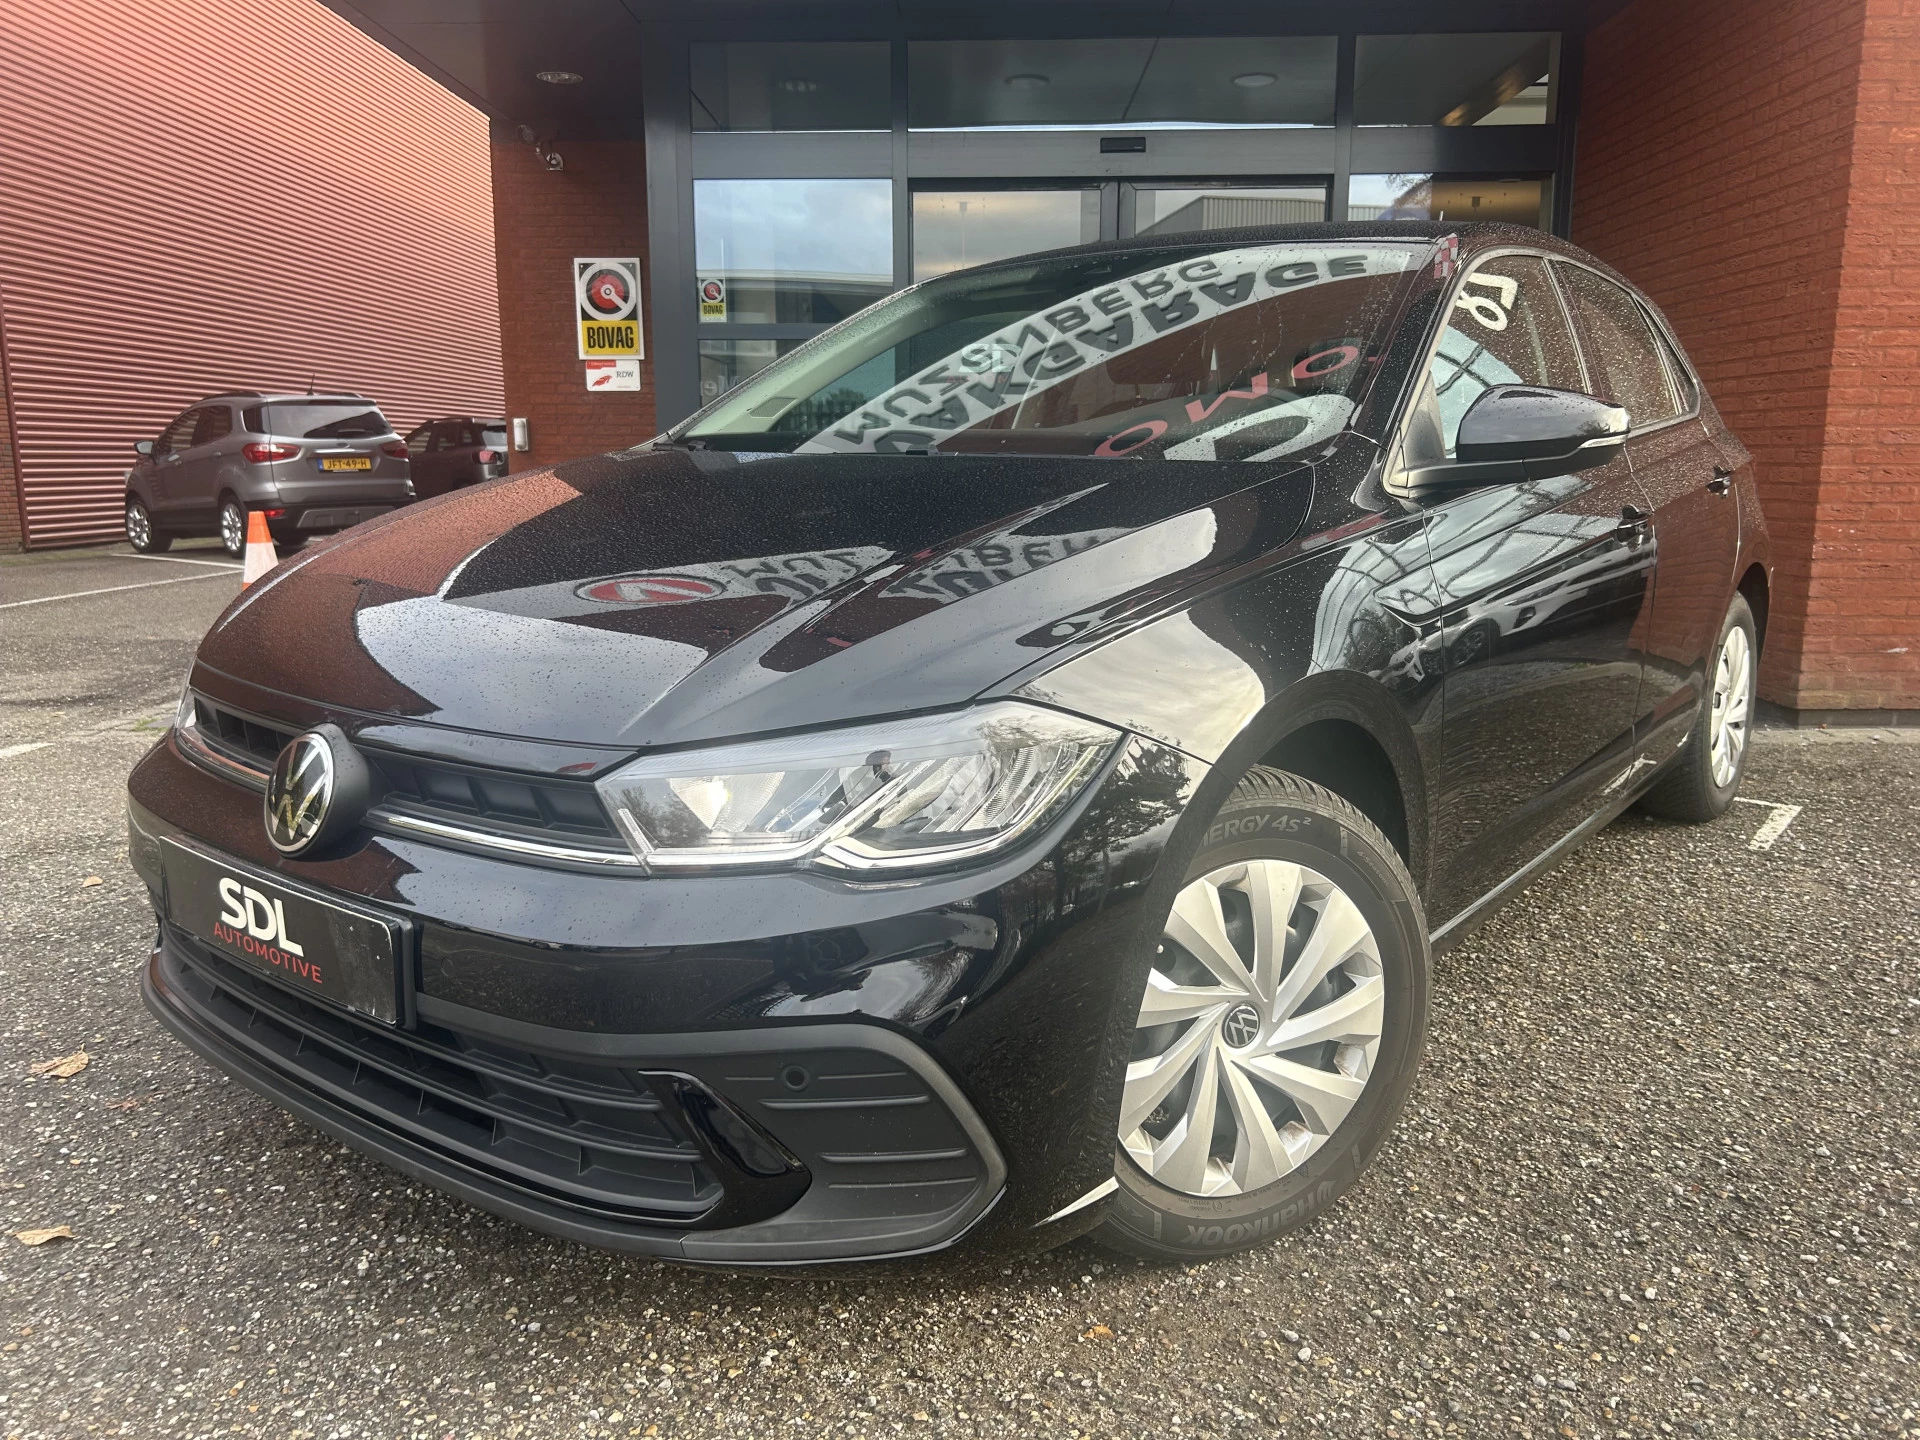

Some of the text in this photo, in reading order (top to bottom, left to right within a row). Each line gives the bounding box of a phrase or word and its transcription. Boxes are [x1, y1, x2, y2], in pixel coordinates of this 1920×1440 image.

[704, 305, 723, 315] BOVAG
[587, 326, 634, 349] BOVAG
[327, 459, 367, 469] JFT-49-H
[219, 877, 304, 957] SDL
[213, 922, 323, 984] AUTOMOTIVE
